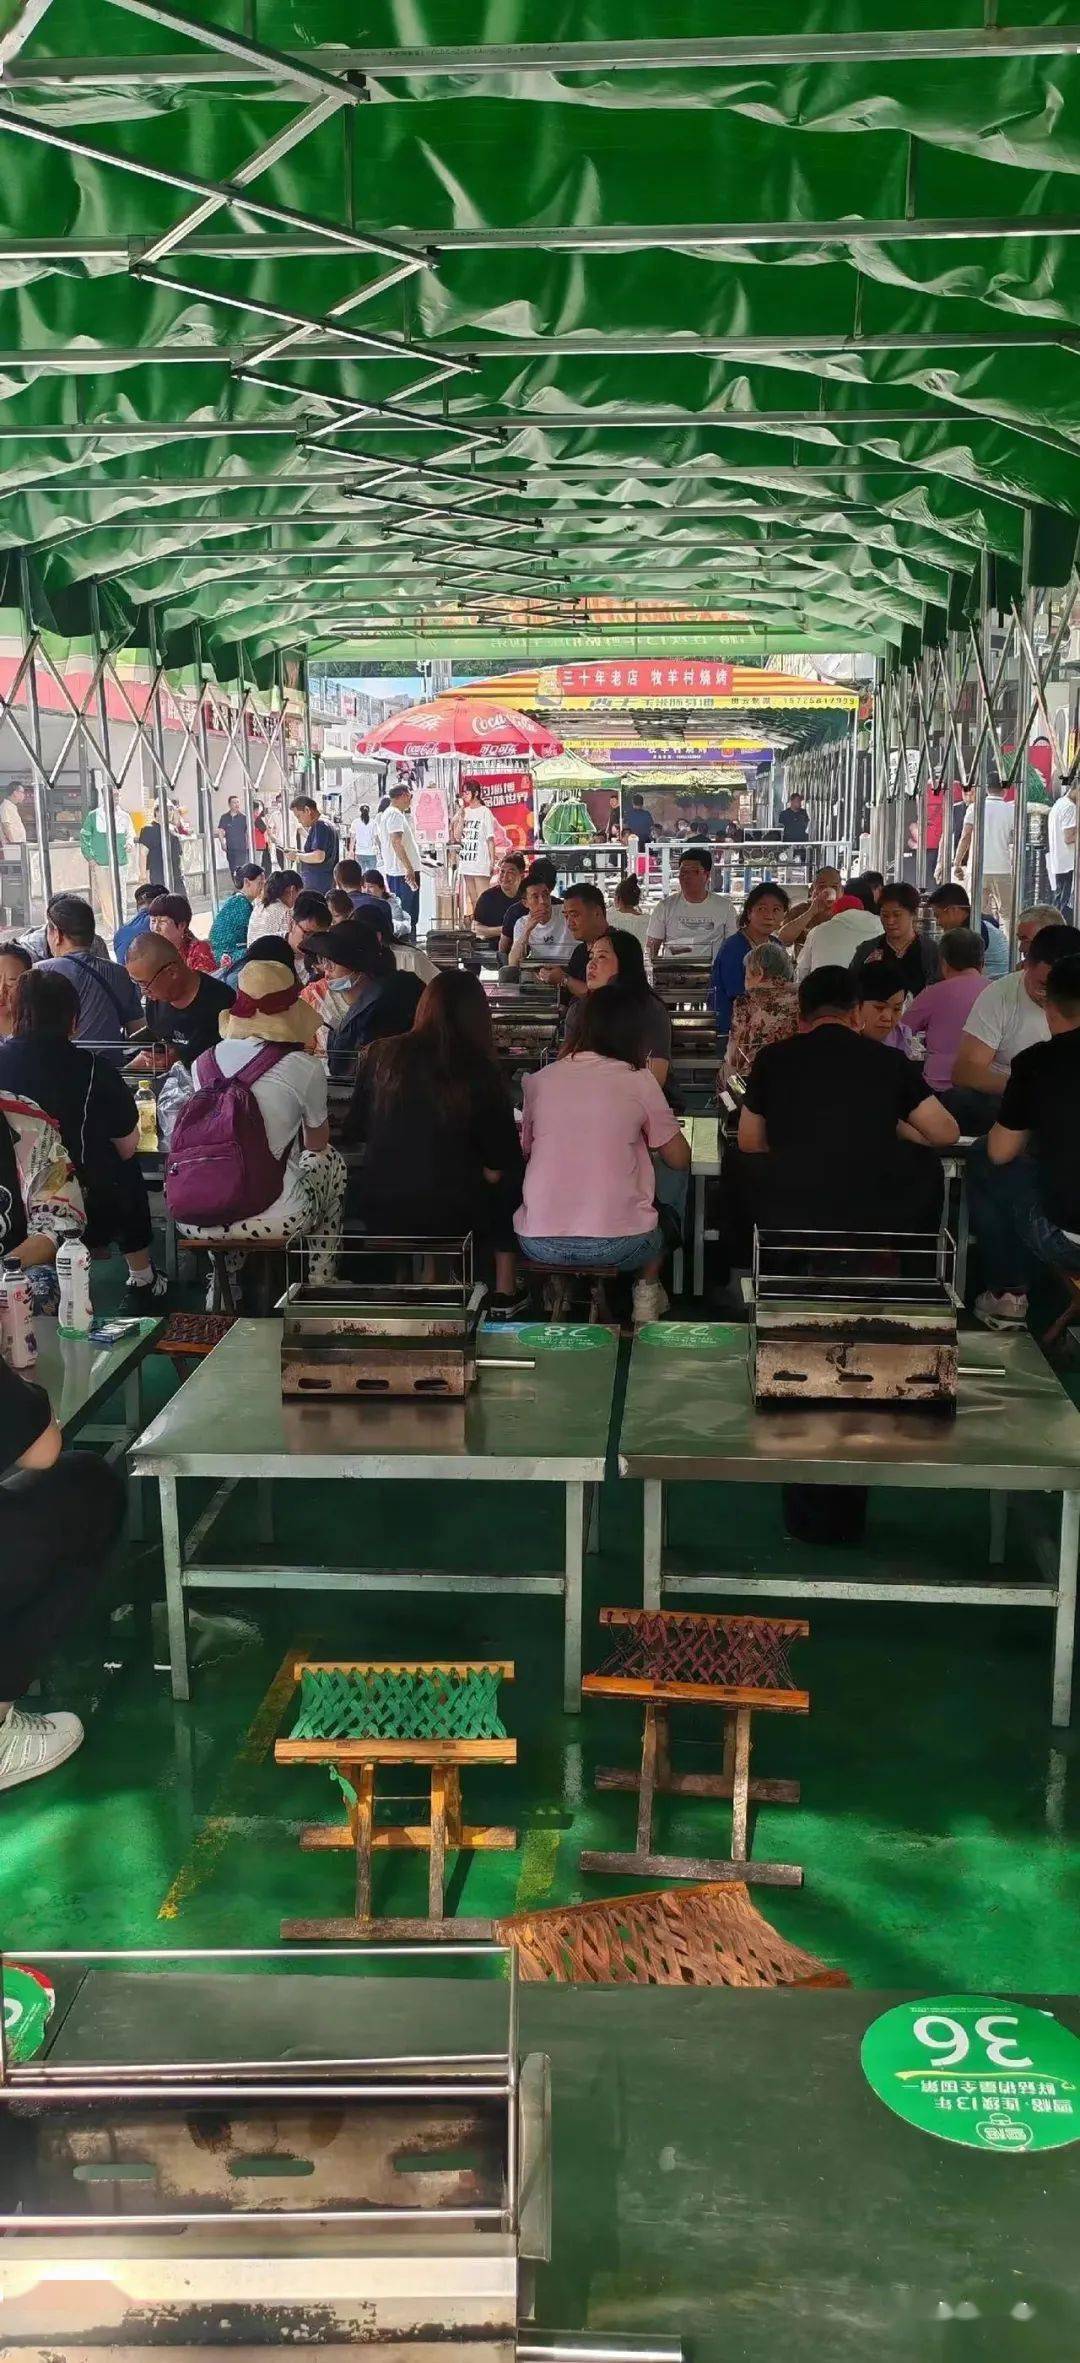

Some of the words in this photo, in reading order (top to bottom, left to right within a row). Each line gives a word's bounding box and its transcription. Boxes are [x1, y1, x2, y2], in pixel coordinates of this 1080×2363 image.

[563, 670, 639, 686] 三十年老店
[651, 668, 727, 686] 牧羊村烧烤
[480, 743, 518, 757] 可口可乐
[912, 2014, 1033, 2068] 36
